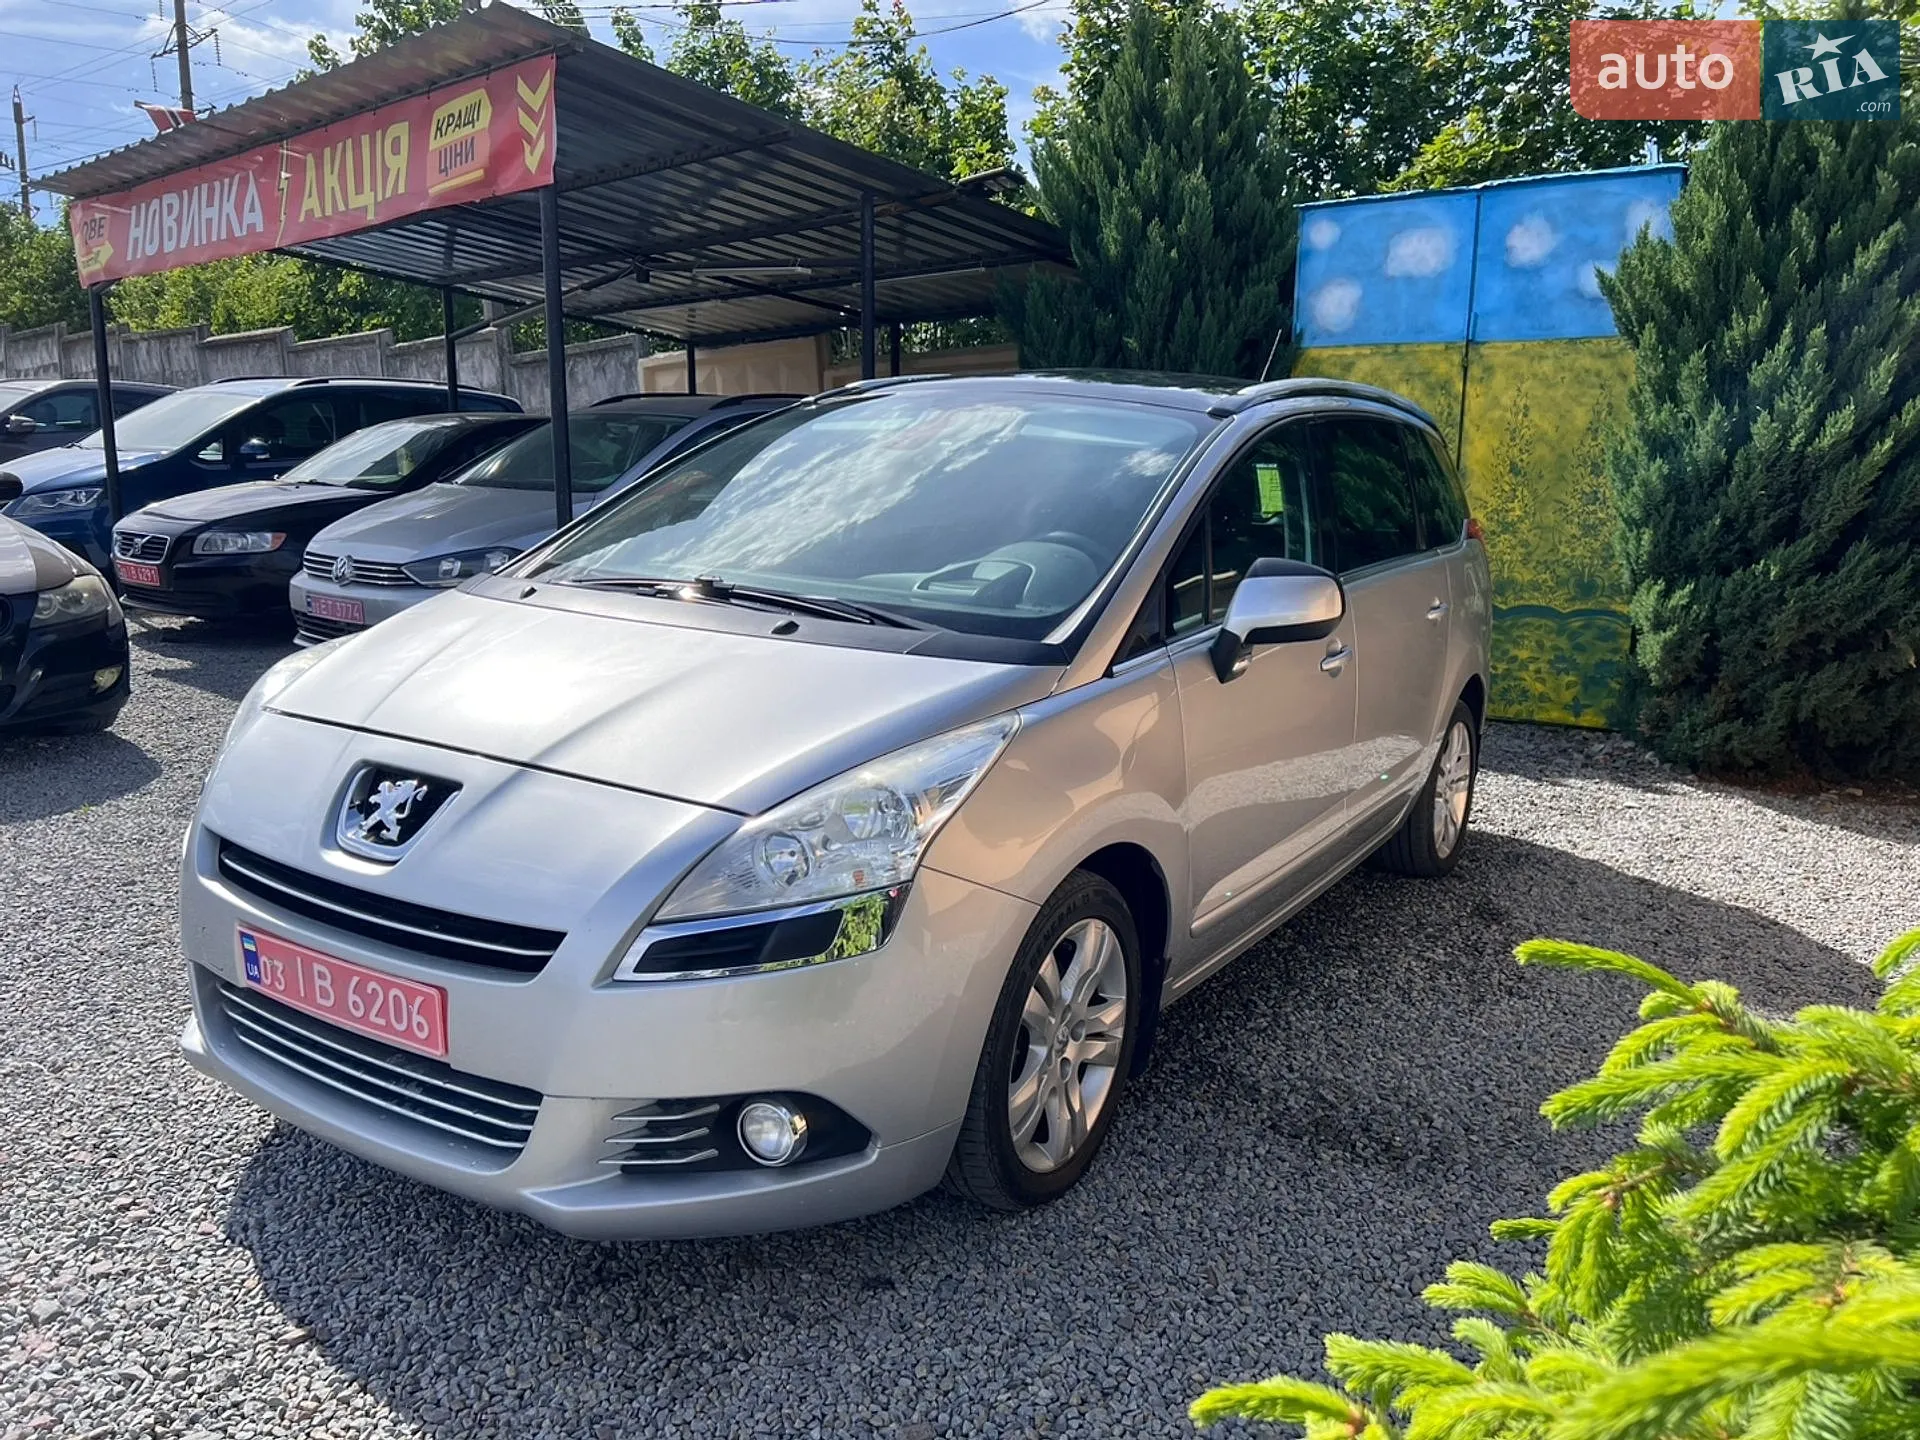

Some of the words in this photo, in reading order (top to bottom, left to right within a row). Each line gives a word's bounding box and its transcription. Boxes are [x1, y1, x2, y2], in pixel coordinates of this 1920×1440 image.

[434, 98, 482, 140] КРАЩІ
[438, 136, 475, 177] ЦІНИ
[126, 169, 264, 261] НОВИНКА
[299, 120, 409, 222] АКЦІЯ
[247, 962, 260, 979] UA
